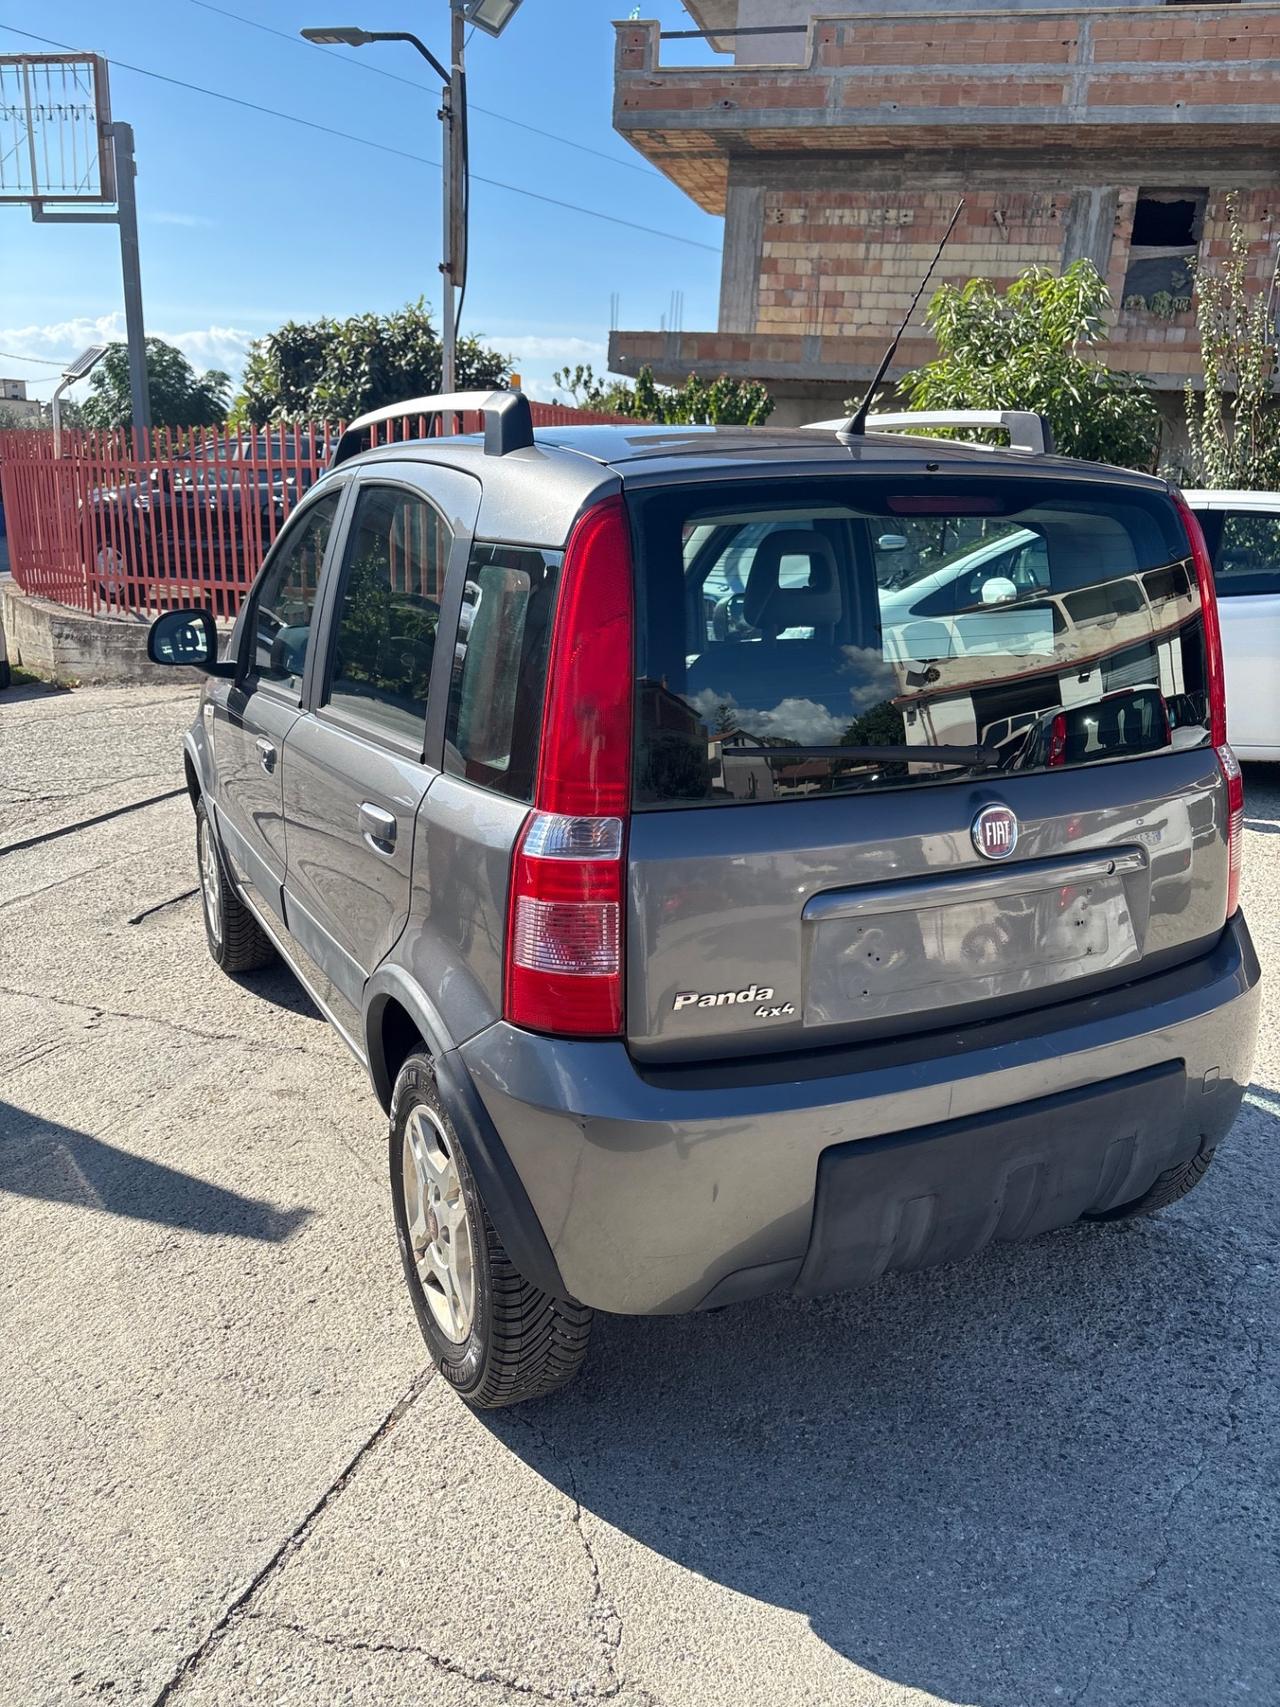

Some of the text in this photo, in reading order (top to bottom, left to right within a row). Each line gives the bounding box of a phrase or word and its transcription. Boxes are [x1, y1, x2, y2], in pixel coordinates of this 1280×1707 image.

[985, 820, 1010, 846] FIAT
[672, 985, 774, 1010] Panda
[755, 1002, 795, 1018] 4x4
